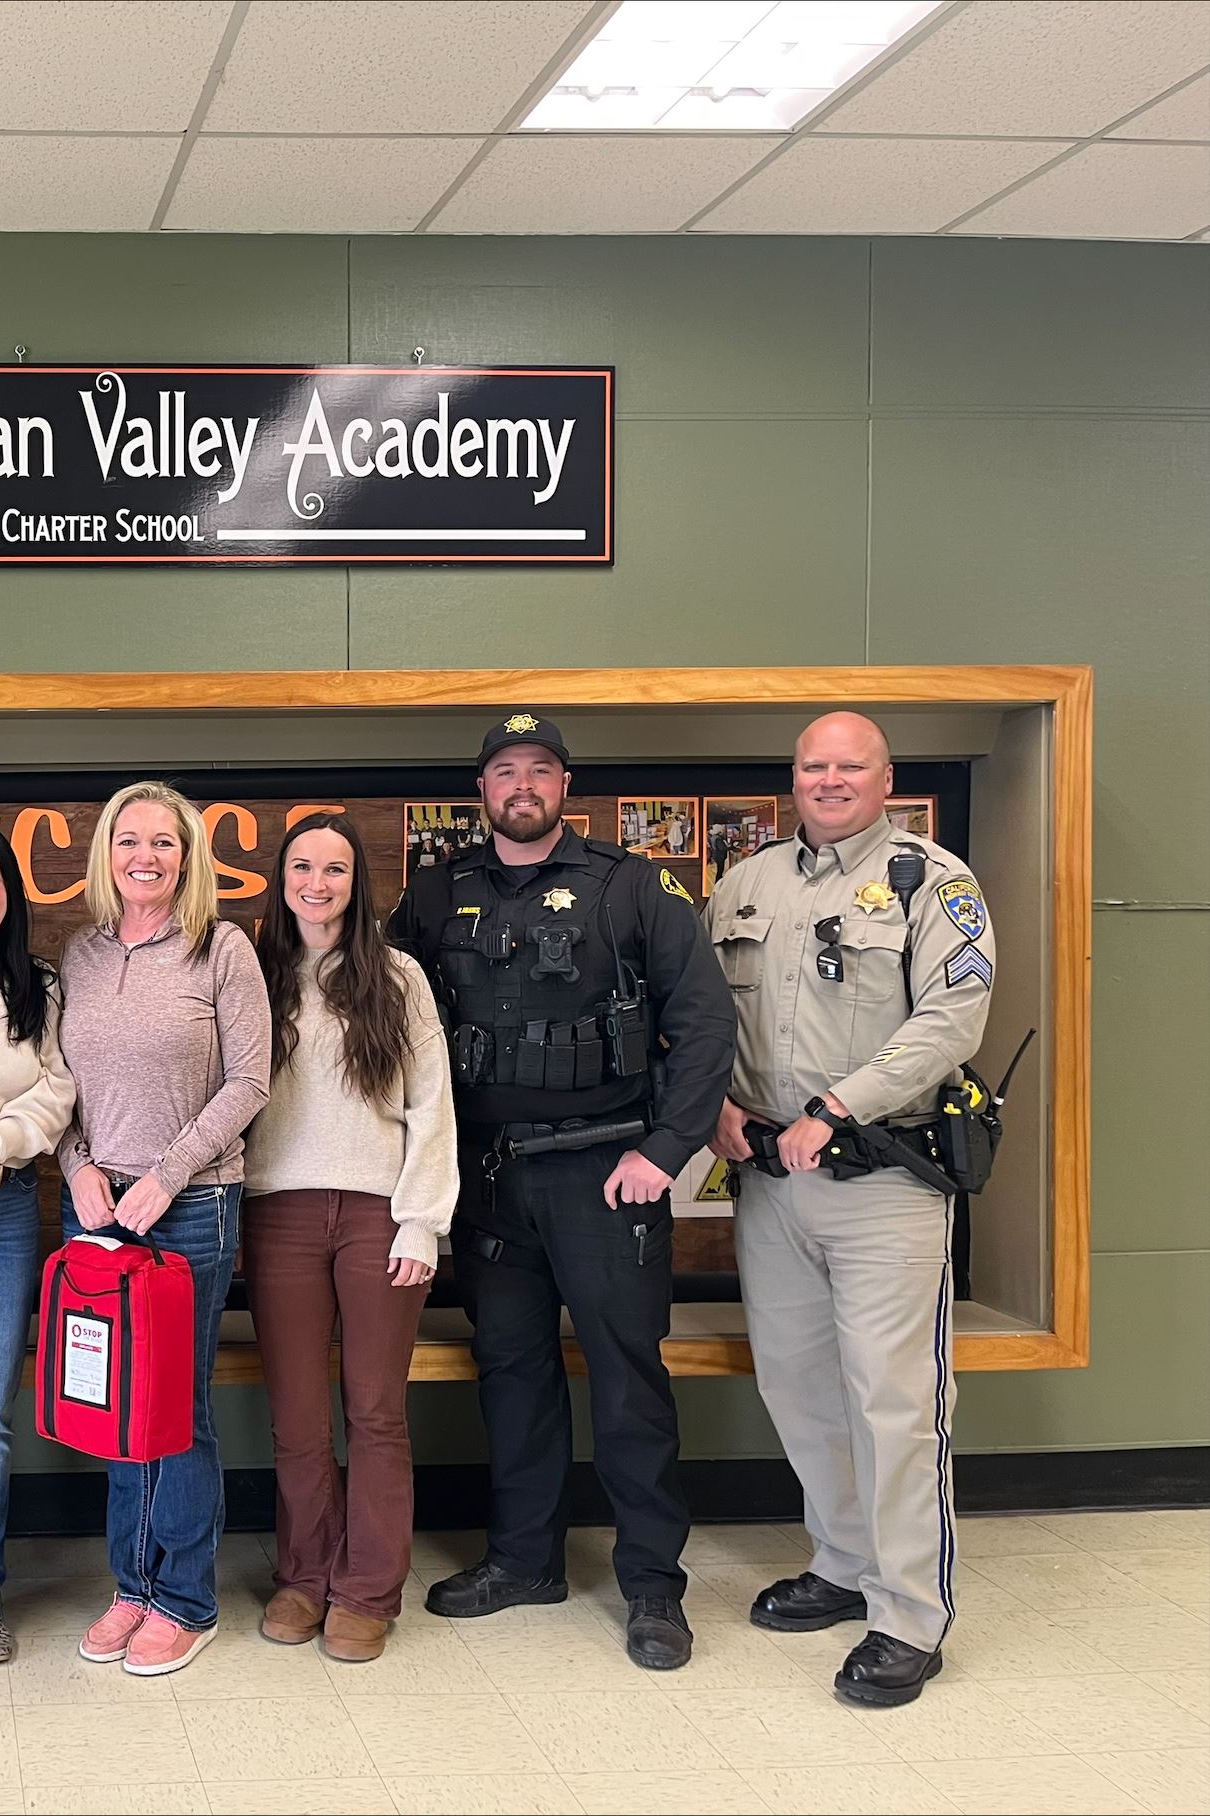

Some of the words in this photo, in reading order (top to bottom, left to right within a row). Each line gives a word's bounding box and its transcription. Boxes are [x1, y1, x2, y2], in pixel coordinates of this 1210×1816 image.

[78, 371, 261, 505] Valley
[282, 386, 577, 520] Academy
[1, 508, 107, 542] CHARTER
[115, 508, 206, 542] SCHOOL
[83, 1328, 102, 1338] STOP
